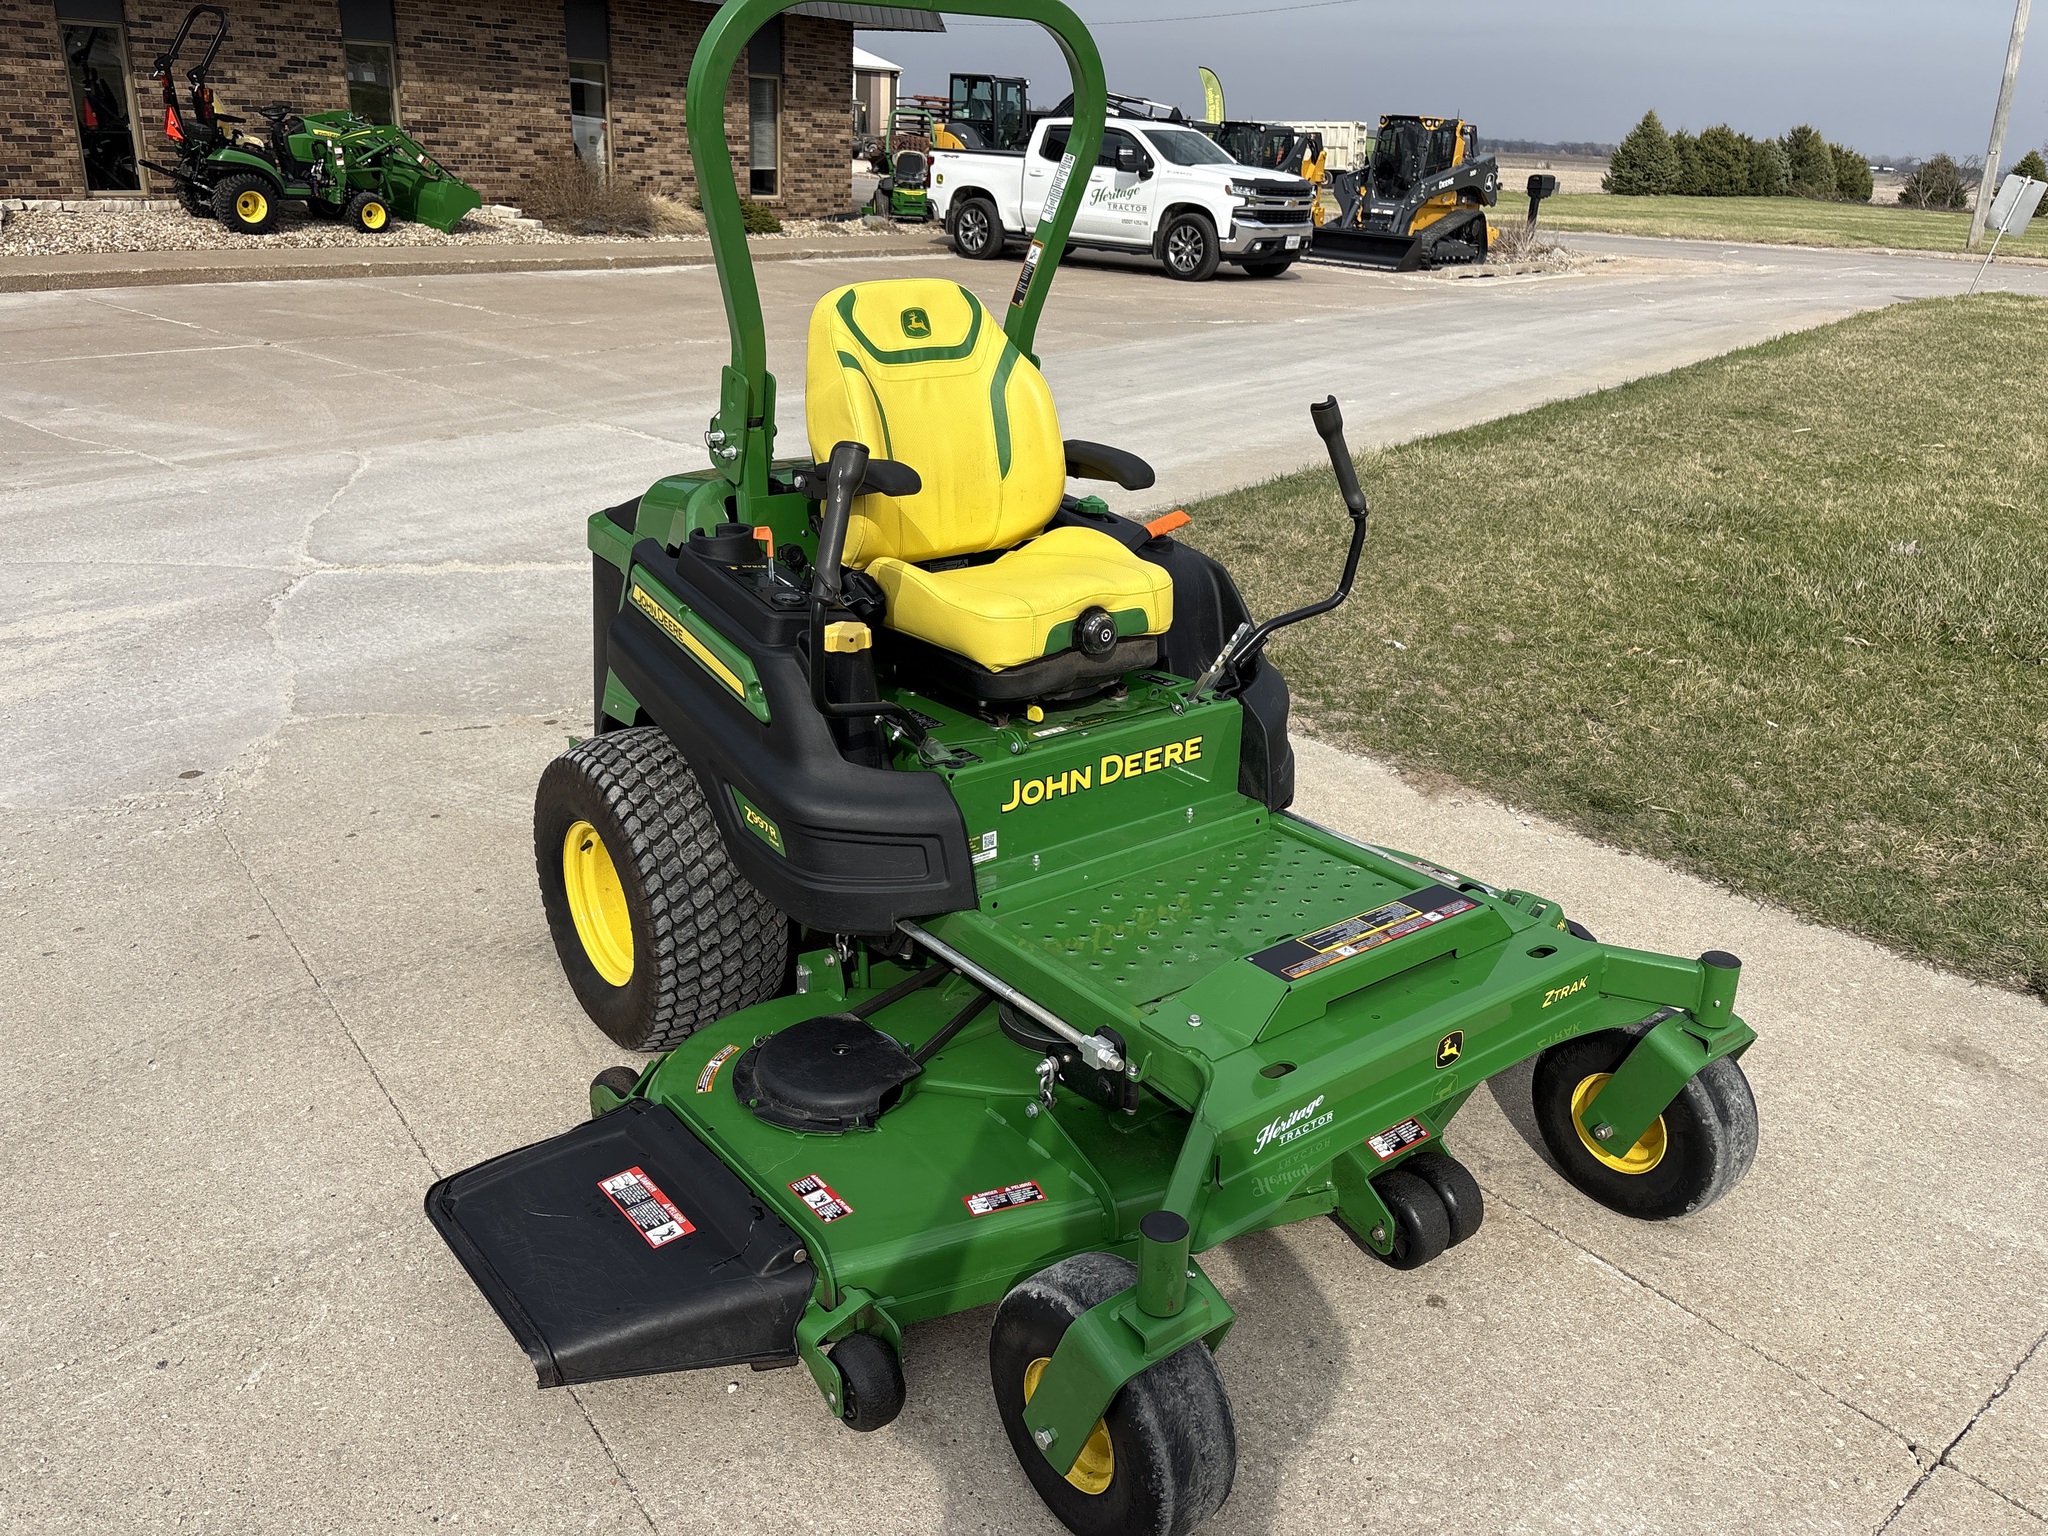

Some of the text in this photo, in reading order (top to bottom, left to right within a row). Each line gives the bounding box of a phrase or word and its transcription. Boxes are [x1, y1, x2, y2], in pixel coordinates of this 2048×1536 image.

[1090, 186, 1140, 206] Heritage
[1107, 202, 1147, 213] TRACTOR
[637, 591, 684, 643] JOHN DEERE
[1001, 735, 1203, 813] JOHN DEERE
[1541, 974, 1589, 1009] ZTRAK
[1253, 1094, 1325, 1155] Heritage
[1279, 1111, 1334, 1146] TRACTOR
[977, 1189, 999, 1198] DANGER
[1011, 1181, 1032, 1190] PELIGRO
